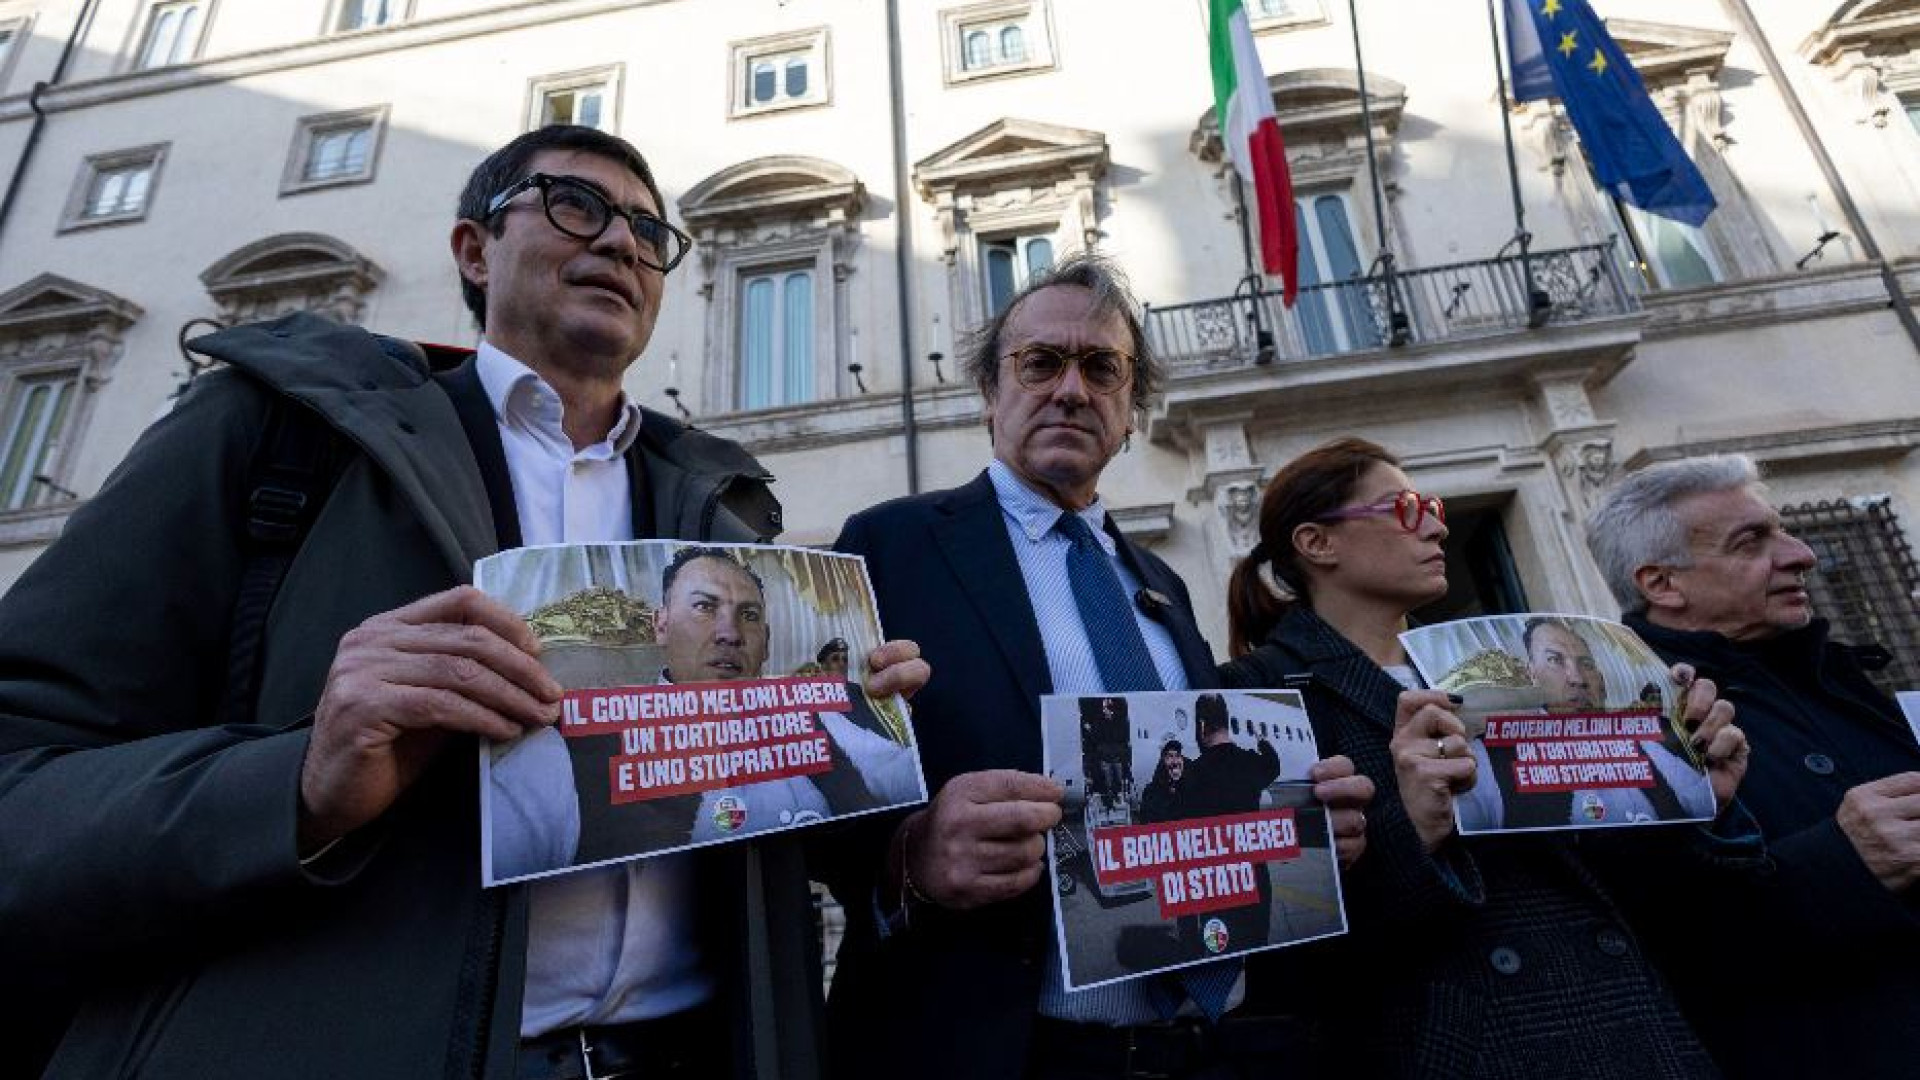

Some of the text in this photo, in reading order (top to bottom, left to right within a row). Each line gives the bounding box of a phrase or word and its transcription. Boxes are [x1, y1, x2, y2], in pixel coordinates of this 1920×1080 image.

[563, 682, 849, 725] IL GOVERNO MELONI LIBERA
[623, 711, 814, 755] UN TORTURATORE
[1485, 715, 1662, 739] IL GOVERNO MELONI LIBERA
[618, 737, 831, 791] E UNO STUPRATORE
[1516, 739, 1639, 762] UN TORTURATORE
[1516, 760, 1654, 787] E UNO STUPRATORE
[1096, 818, 1297, 871] IL BOIA NELL'AEREO
[1162, 861, 1256, 904] DI STATO
